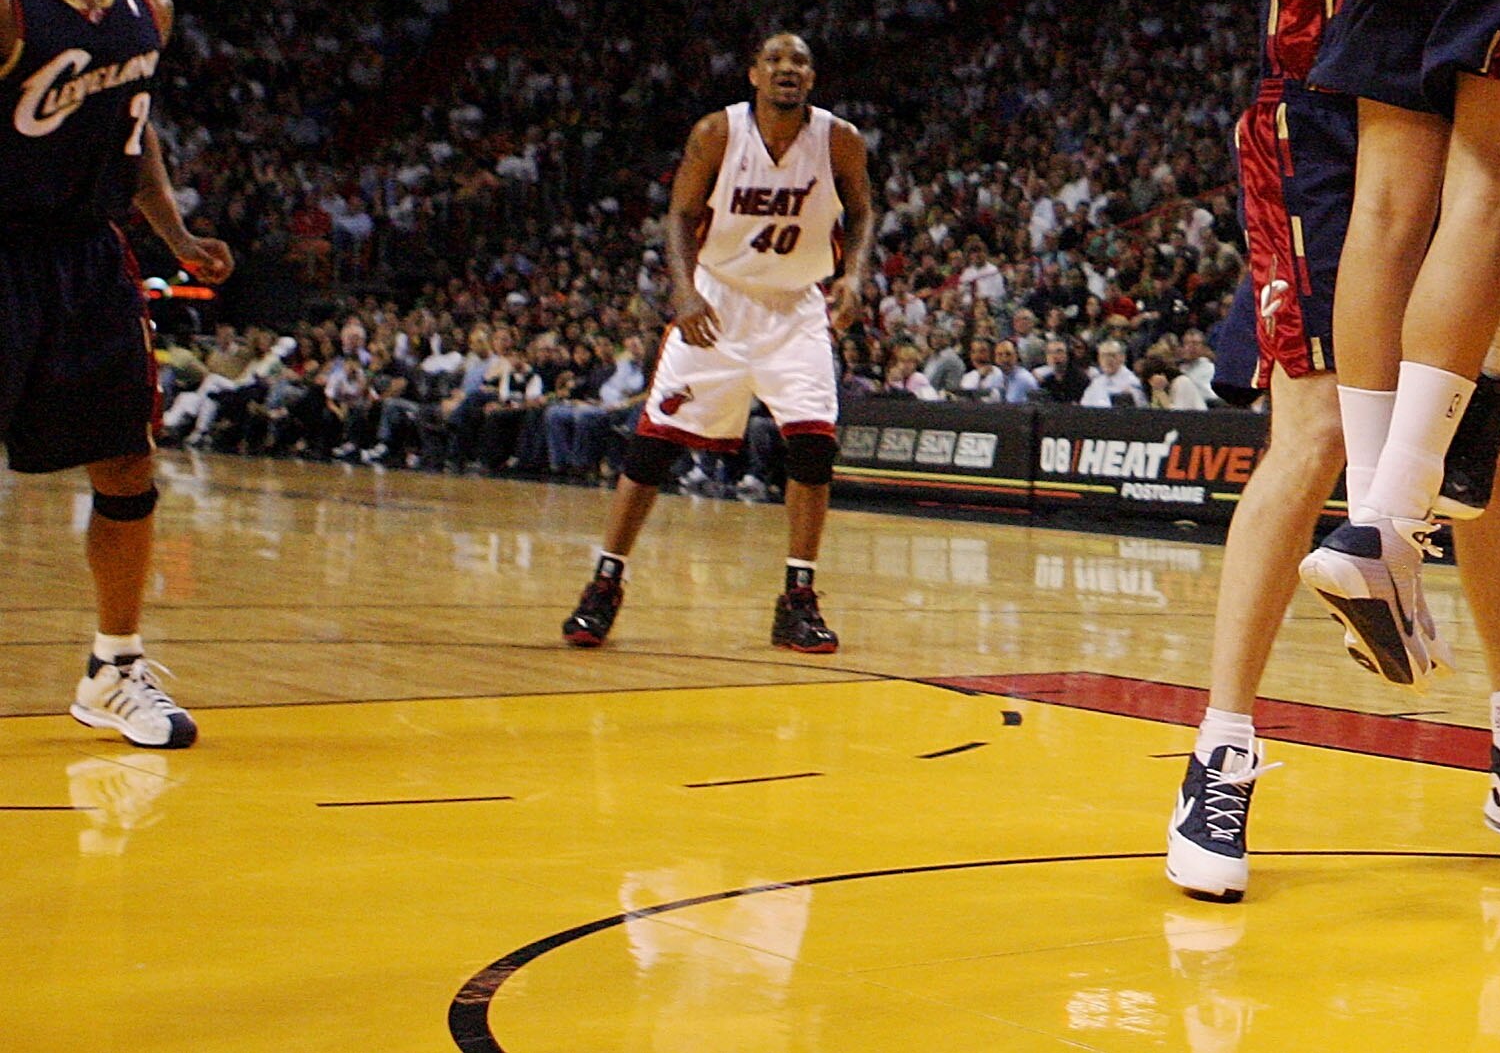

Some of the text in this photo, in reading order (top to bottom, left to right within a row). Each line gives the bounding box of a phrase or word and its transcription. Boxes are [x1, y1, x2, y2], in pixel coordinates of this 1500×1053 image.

[730, 177, 818, 217] HEAT
[751, 224, 803, 255] 40
[1040, 437, 1071, 473] 08
[1121, 482, 1206, 504] POSTGAME
